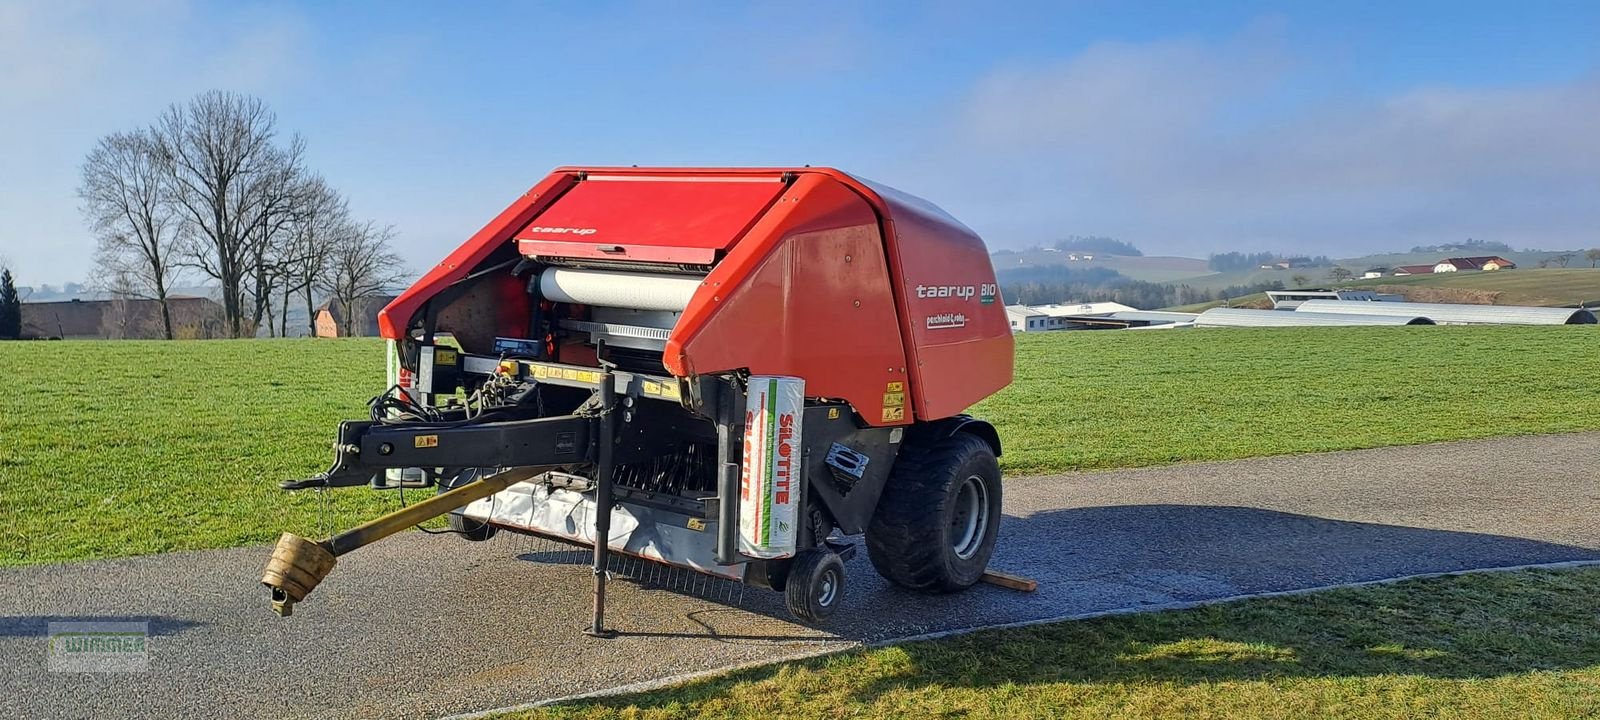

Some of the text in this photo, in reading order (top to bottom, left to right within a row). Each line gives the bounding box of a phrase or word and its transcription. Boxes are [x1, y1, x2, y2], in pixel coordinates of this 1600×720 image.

[532, 226, 597, 236] taarup
[916, 283, 996, 301] taarup BIO
